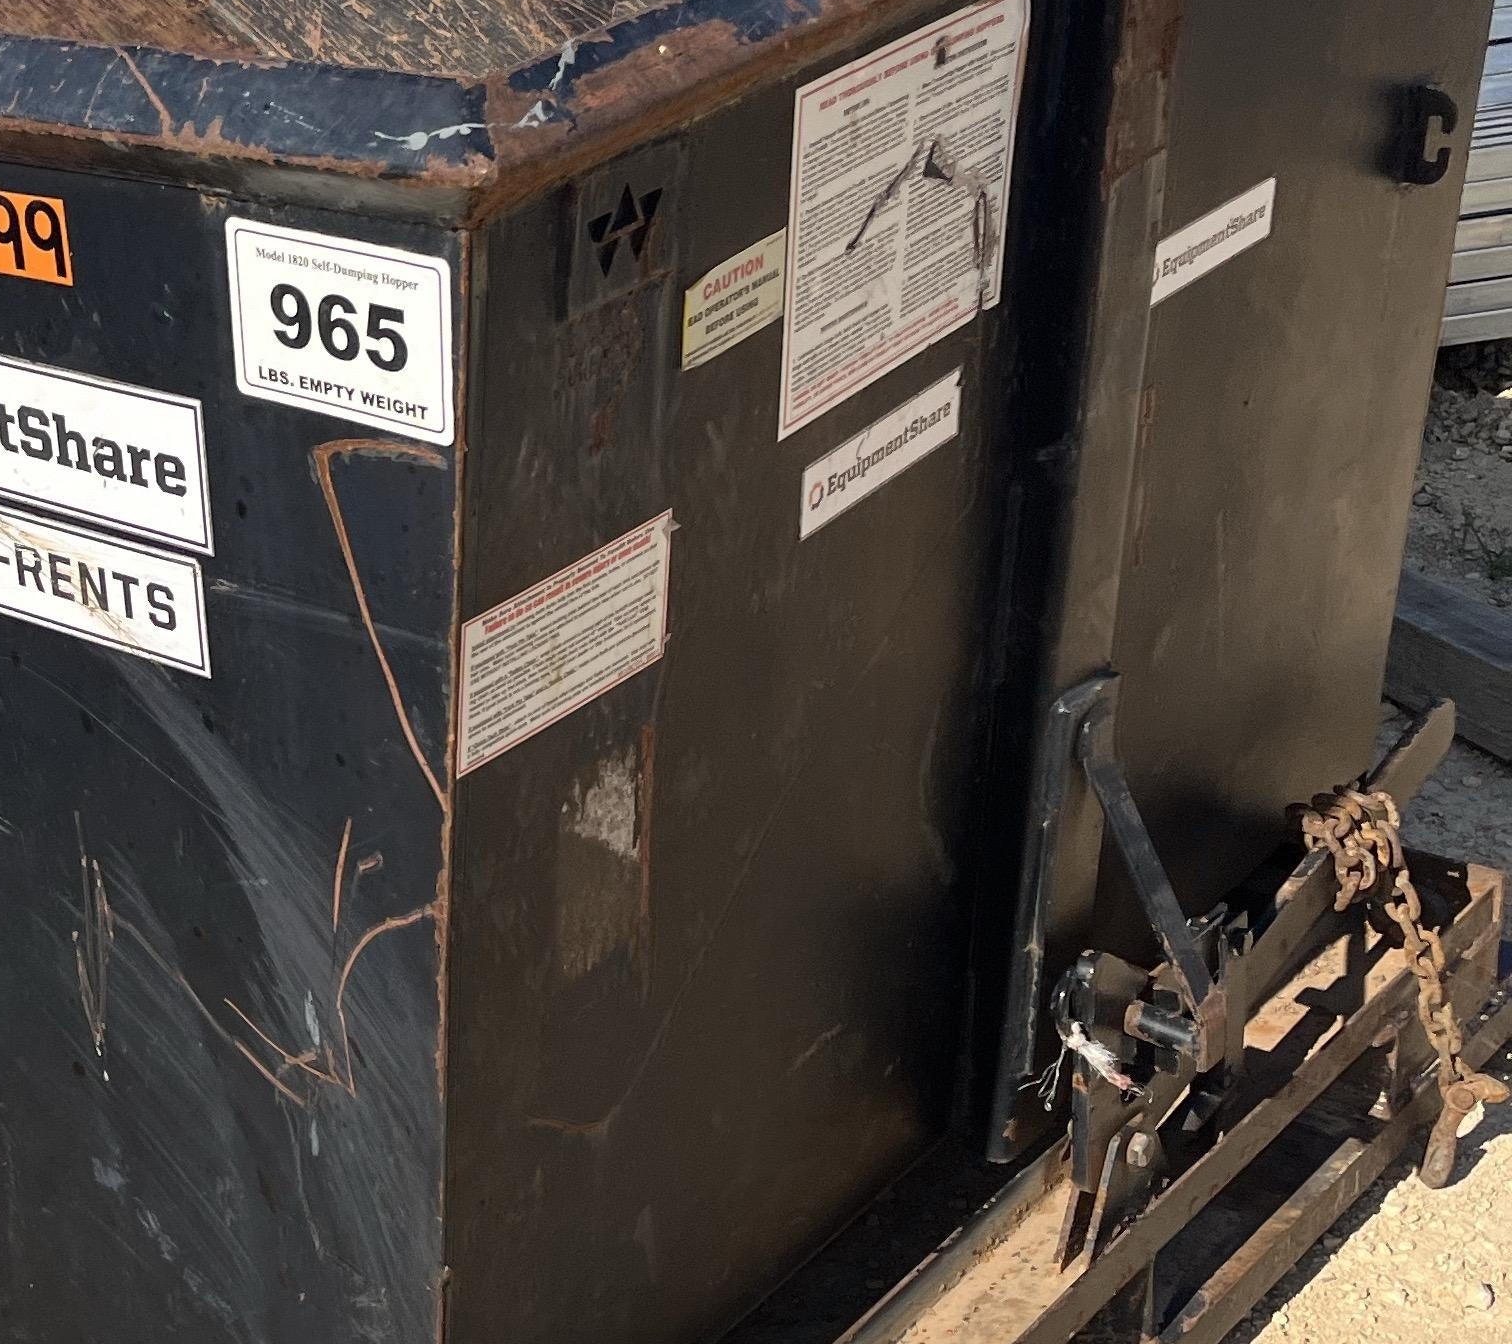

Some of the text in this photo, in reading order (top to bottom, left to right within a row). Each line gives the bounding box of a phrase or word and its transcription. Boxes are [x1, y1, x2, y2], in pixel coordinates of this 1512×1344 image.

[256, 247, 419, 292] Model 1820 Self-Dumping Hopper
[1162, 204, 1266, 278] EquipmentShare
[703, 254, 764, 301] CAUTION
[270, 283, 408, 373] 965
[259, 365, 428, 420] LBS. EMPTY WEIGHT
[826, 401, 952, 497] EquipmentShare
